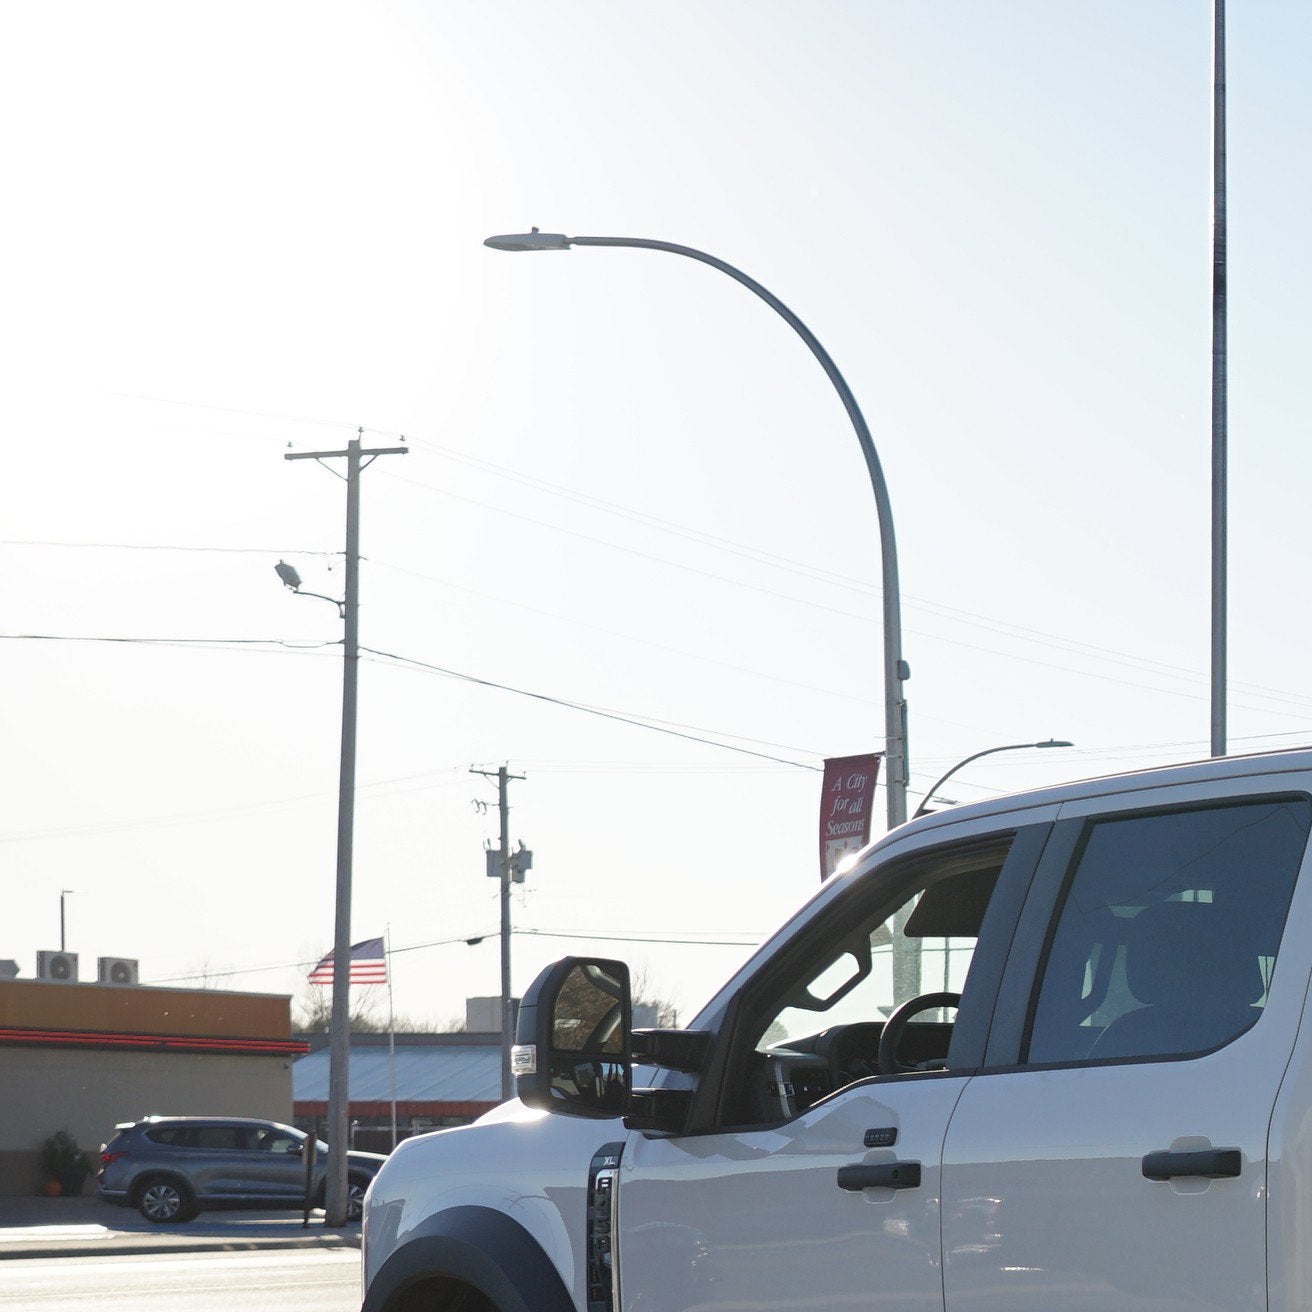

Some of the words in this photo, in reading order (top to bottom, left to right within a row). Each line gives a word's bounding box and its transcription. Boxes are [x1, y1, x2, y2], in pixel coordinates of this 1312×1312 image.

[832, 776, 842, 791] A
[847, 773, 867, 792] City
[830, 796, 849, 816] for
[849, 797, 864, 814] all
[826, 819, 864, 836] Seasons
[603, 1156, 616, 1166] XL
